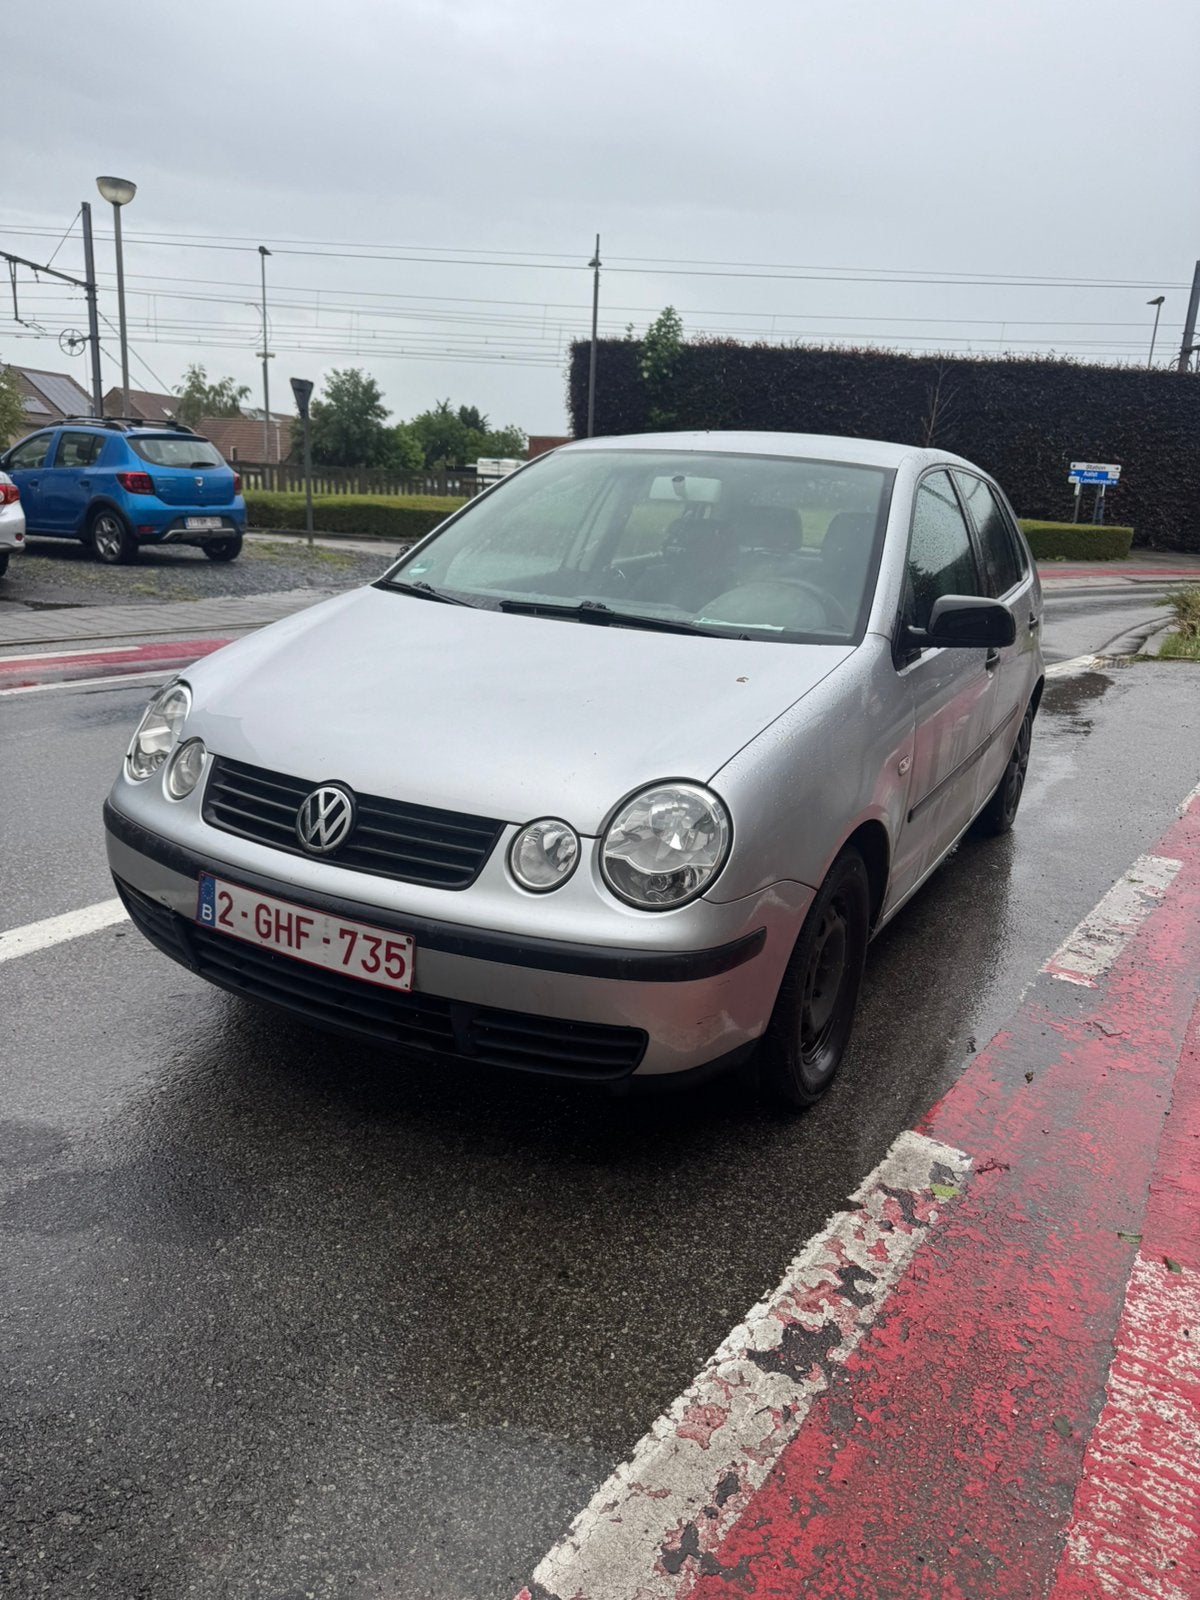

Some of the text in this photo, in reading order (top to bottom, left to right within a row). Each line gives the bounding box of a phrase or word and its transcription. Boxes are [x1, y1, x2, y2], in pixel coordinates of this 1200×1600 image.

[296, 786, 352, 852] VW
[201, 903, 212, 921] B
[218, 890, 407, 979] 2-GHF-735
